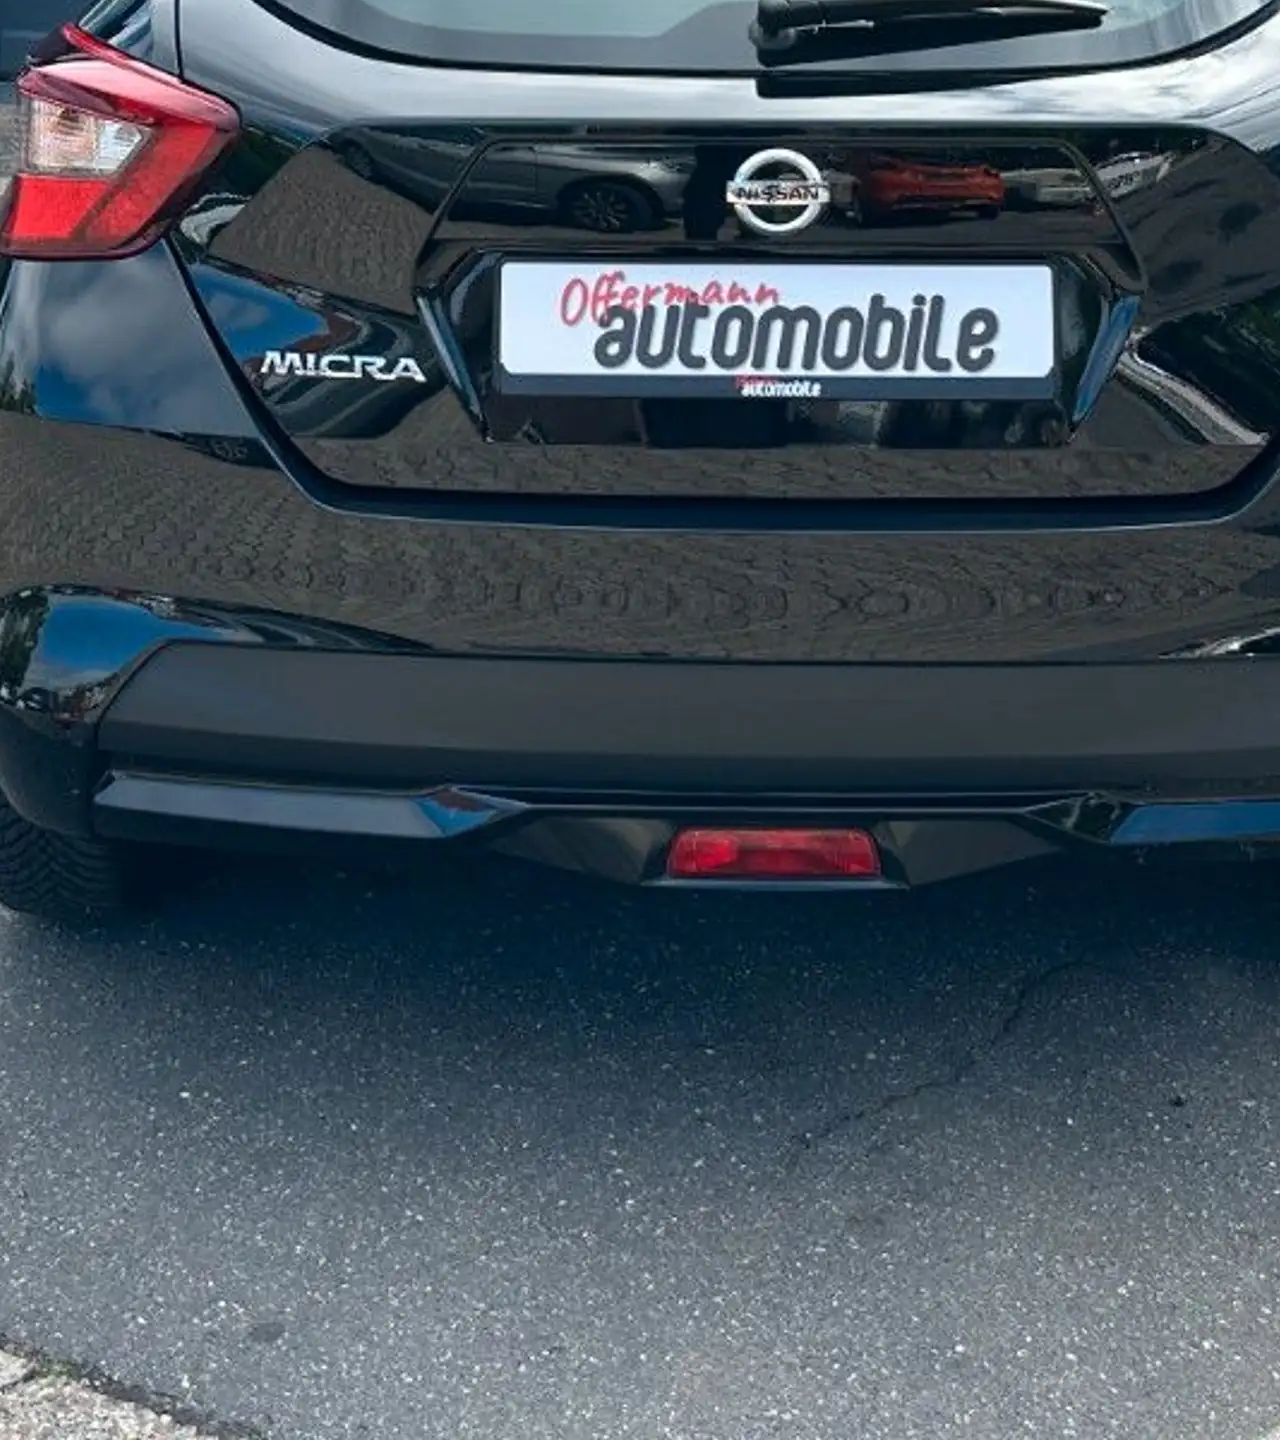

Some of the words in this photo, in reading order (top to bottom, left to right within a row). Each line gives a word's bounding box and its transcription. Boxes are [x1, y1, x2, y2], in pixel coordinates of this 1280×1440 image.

[732, 184, 820, 202] NISSAN
[559, 271, 781, 327] Offermann
[593, 293, 1001, 372] automobile
[259, 350, 428, 383] MICRA
[740, 379, 822, 398] automobile
